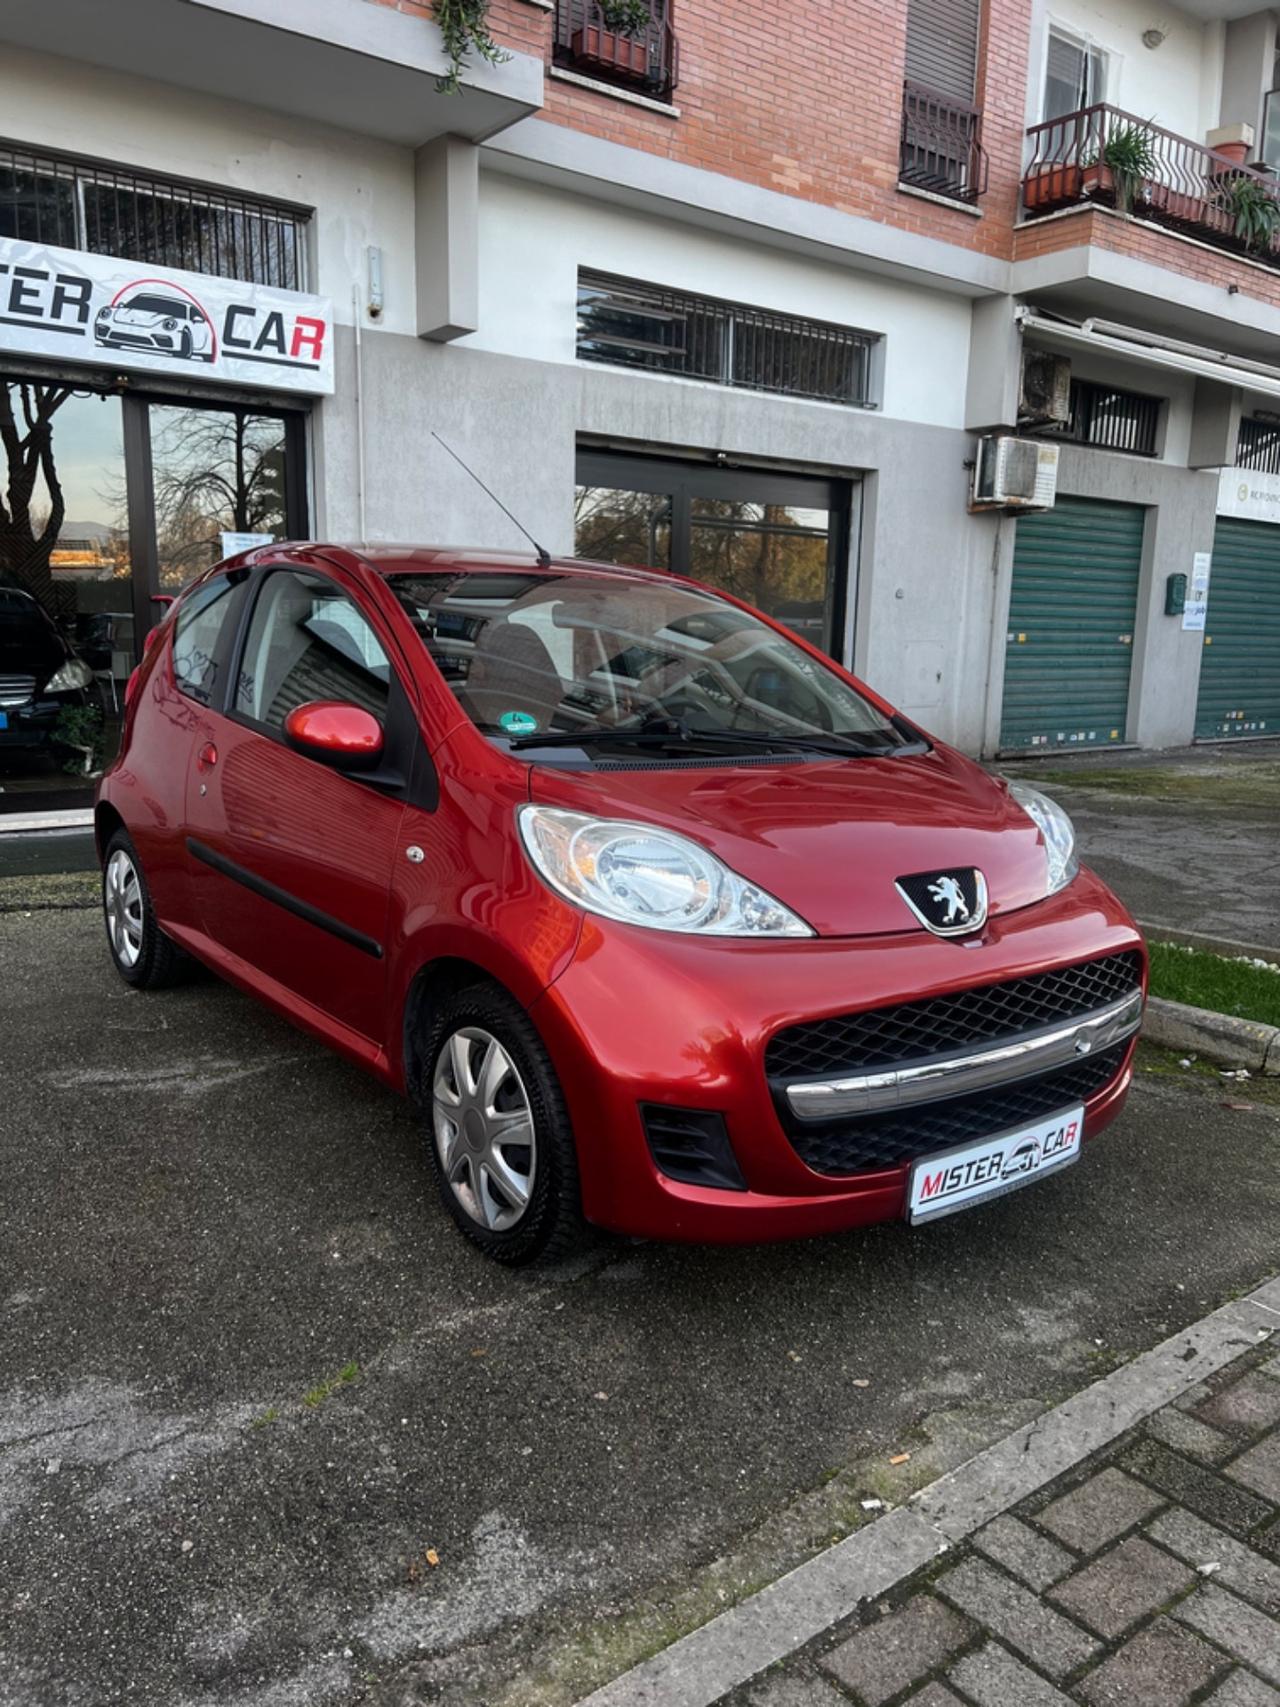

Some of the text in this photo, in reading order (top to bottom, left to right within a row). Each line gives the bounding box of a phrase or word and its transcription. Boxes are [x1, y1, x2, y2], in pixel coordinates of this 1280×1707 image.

[0, 264, 325, 360] ER CAR
[920, 1151, 1004, 1199] MISTER
[1042, 1122, 1078, 1154] CAR
